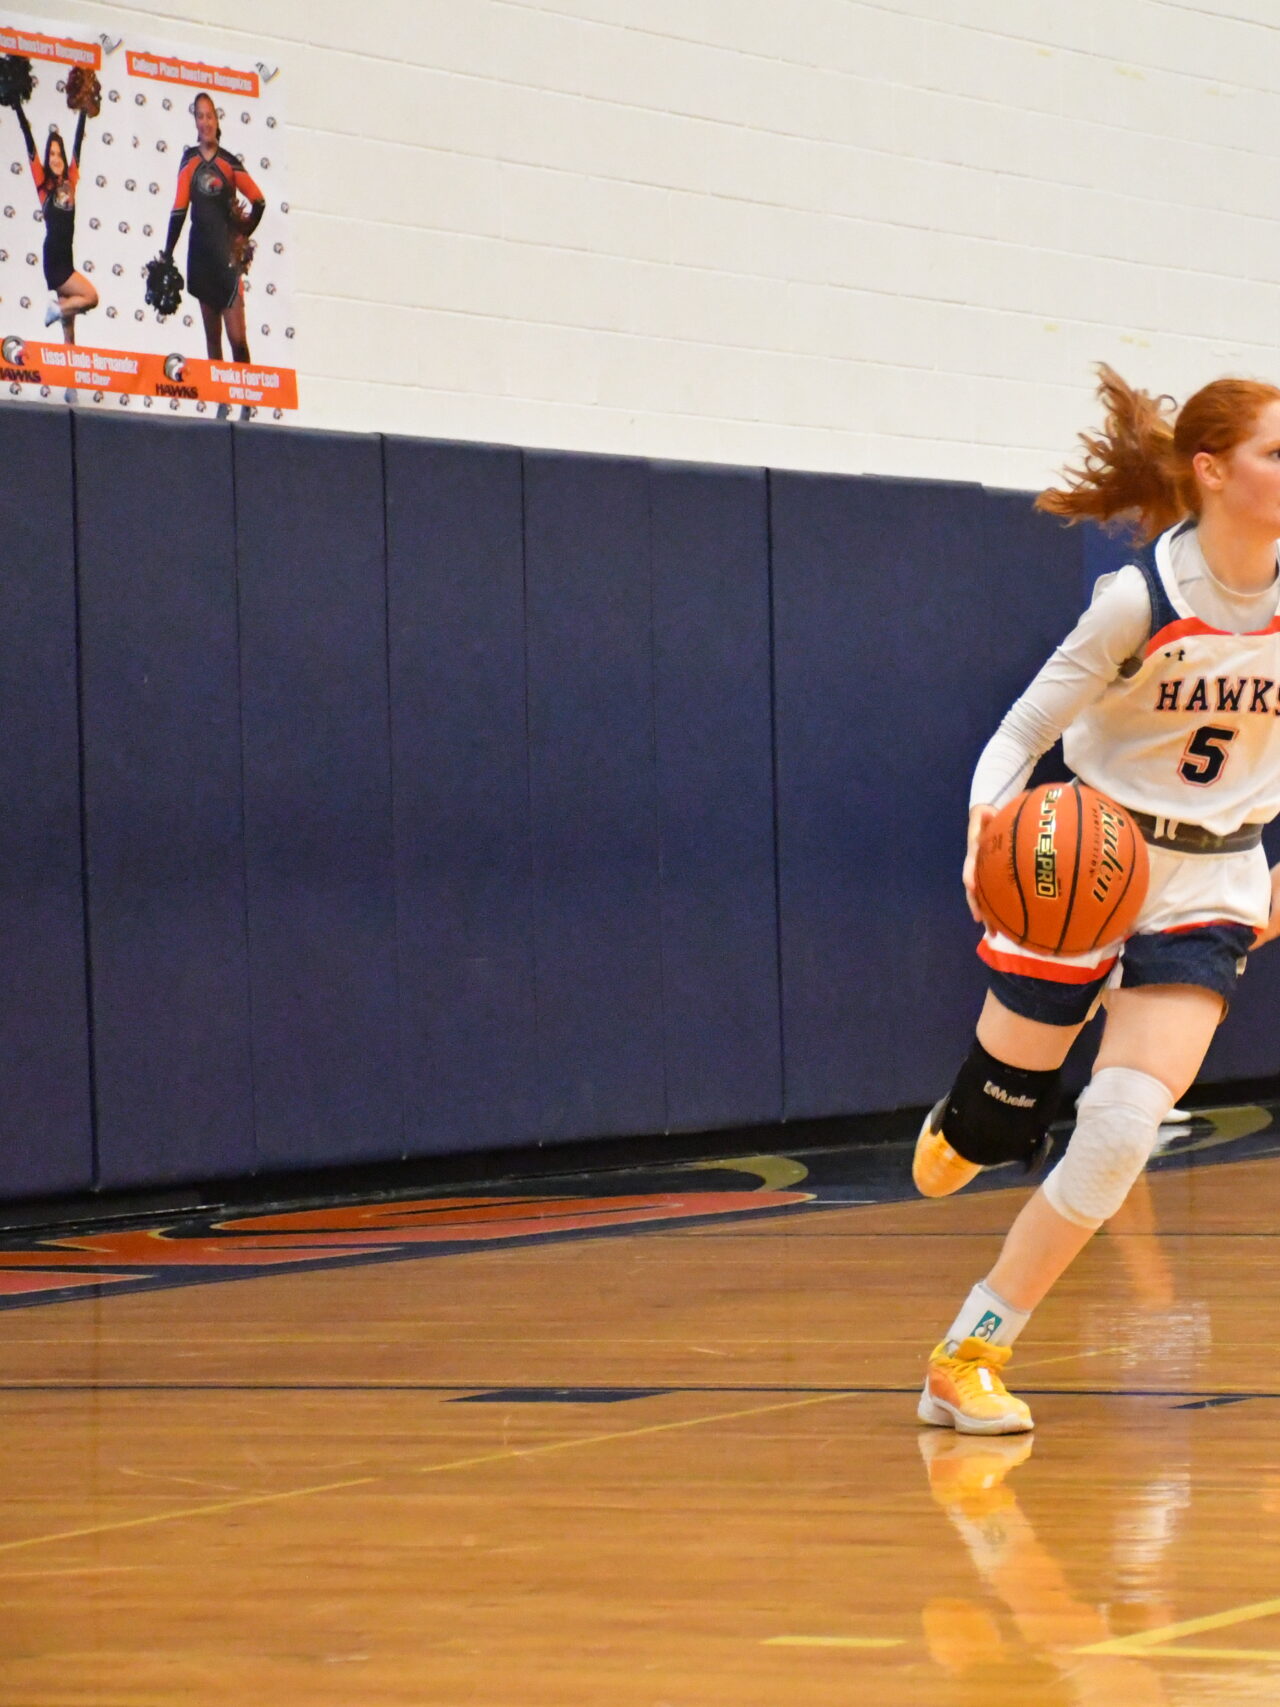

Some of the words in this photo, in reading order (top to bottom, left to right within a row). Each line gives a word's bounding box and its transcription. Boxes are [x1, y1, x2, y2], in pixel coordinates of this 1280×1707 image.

[155, 384, 199, 399] HAWKS
[1177, 723, 1239, 788] 5
[990, 1084, 1037, 1108] Mueller
